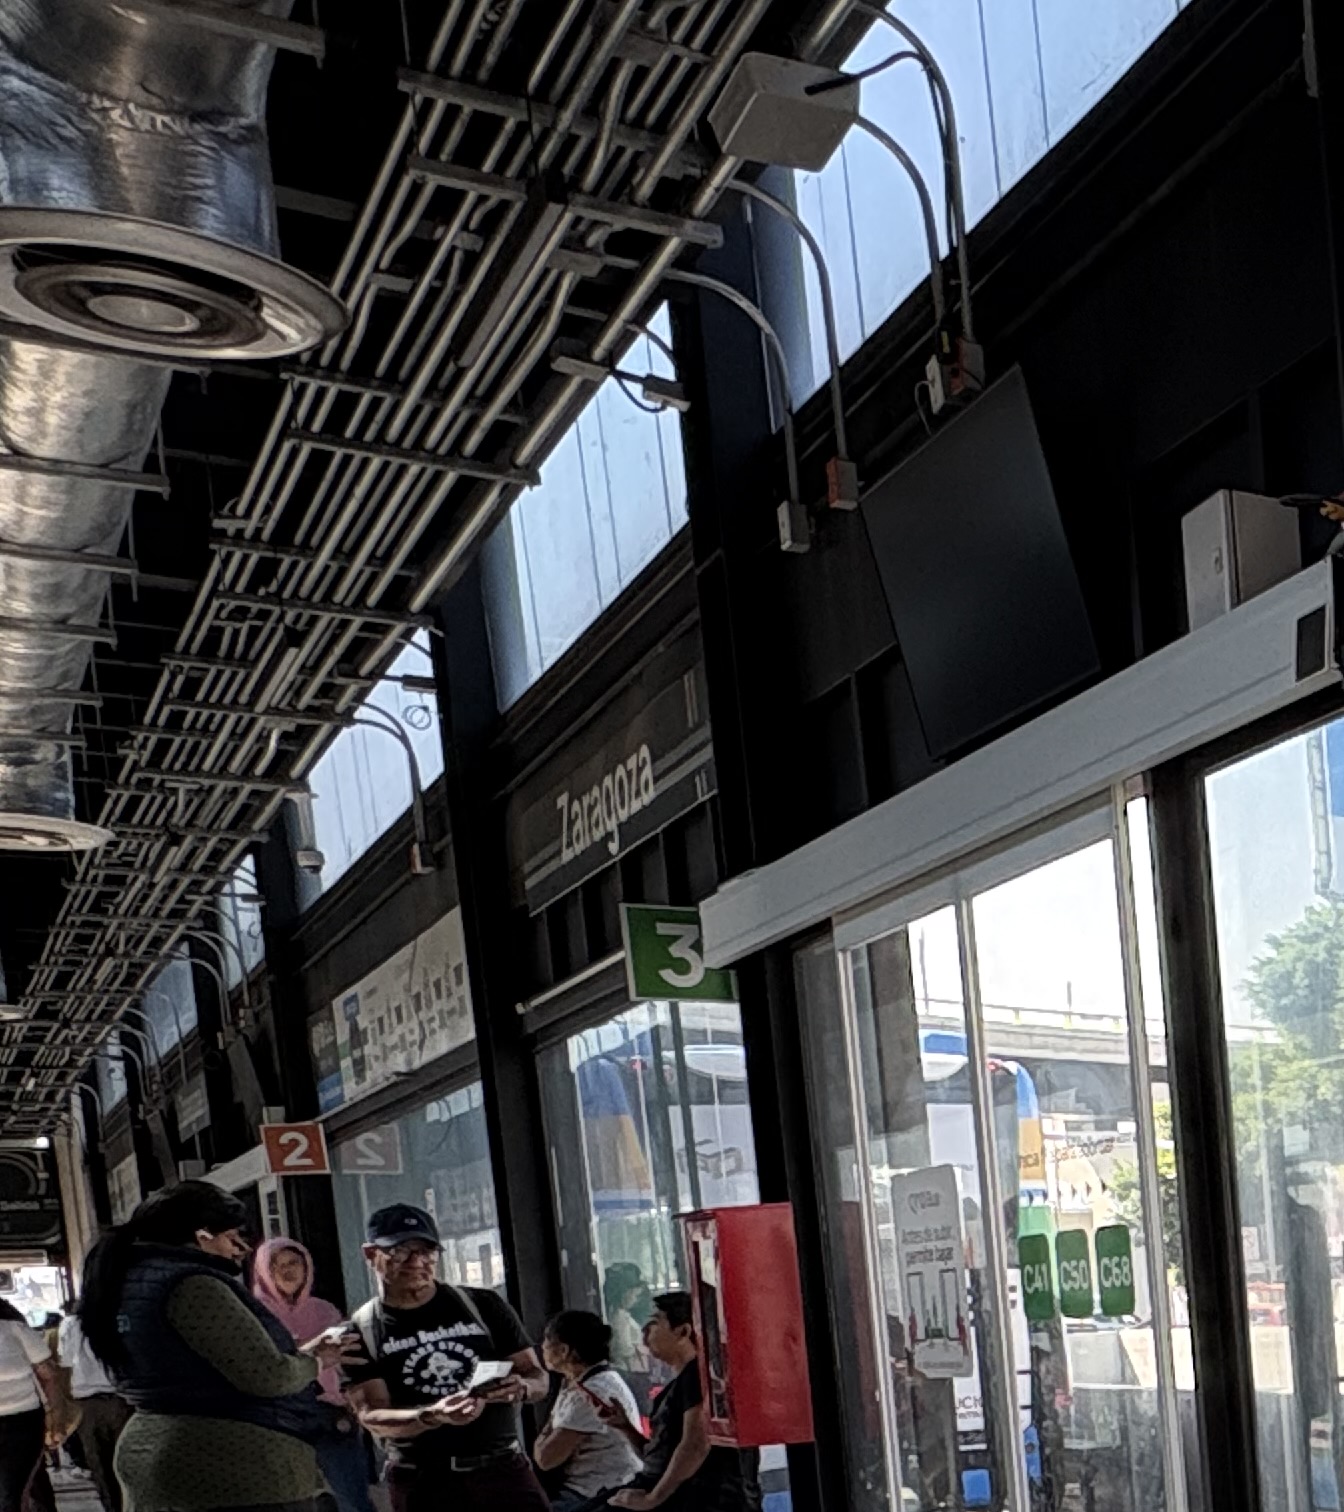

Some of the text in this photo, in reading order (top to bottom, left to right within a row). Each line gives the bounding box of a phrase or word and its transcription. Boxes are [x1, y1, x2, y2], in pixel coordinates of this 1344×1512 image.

[557, 744, 654, 864] Zaragoza
[656, 923, 705, 987] 3
[279, 1131, 313, 1165] 2
[1023, 1257, 1131, 1293] C41 C50 C68
